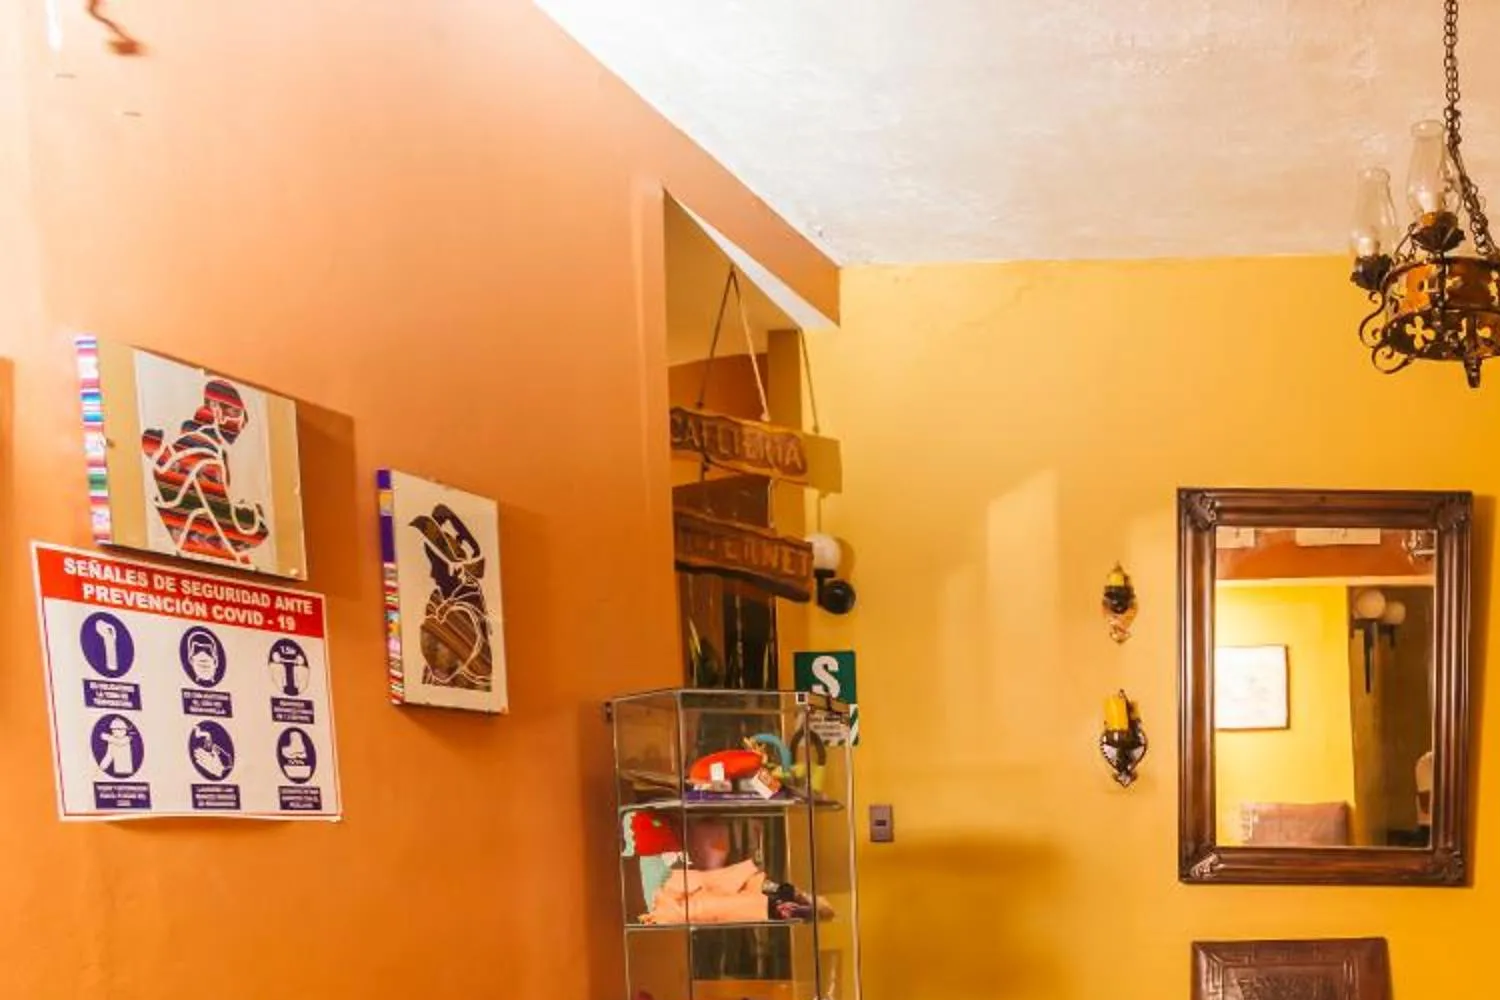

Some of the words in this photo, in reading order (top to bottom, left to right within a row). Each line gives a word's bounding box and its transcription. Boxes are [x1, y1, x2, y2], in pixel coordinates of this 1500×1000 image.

[64, 558, 148, 587] SEÑALES
[153, 576, 177, 592] DE
[180, 578, 271, 608] SEGURIDAD
[275, 598, 313, 615] ANTE
[83, 584, 208, 618] PREVENCIÓN
[212, 605, 263, 627] COVID
[278, 615, 296, 631] 19
[812, 655, 840, 699] S
